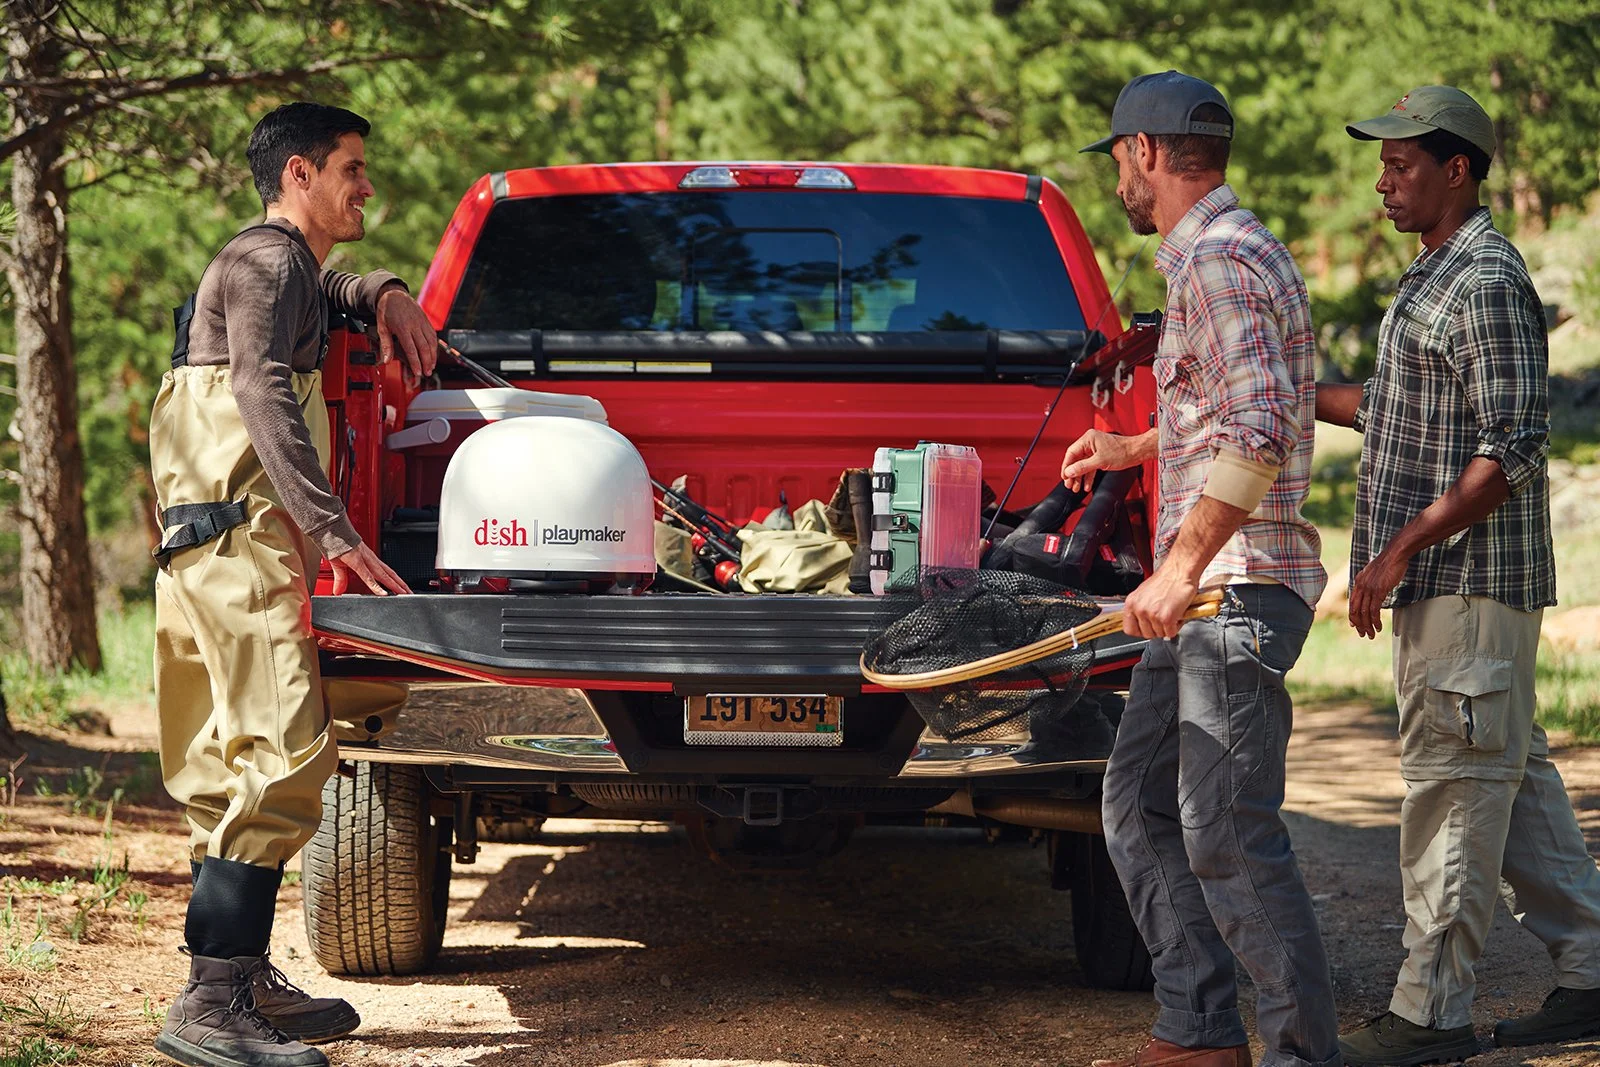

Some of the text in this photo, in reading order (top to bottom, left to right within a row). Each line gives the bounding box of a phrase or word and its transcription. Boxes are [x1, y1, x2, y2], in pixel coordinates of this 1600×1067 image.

[474, 519, 626, 546] dish playmaker
[770, 697, 827, 723] 534
